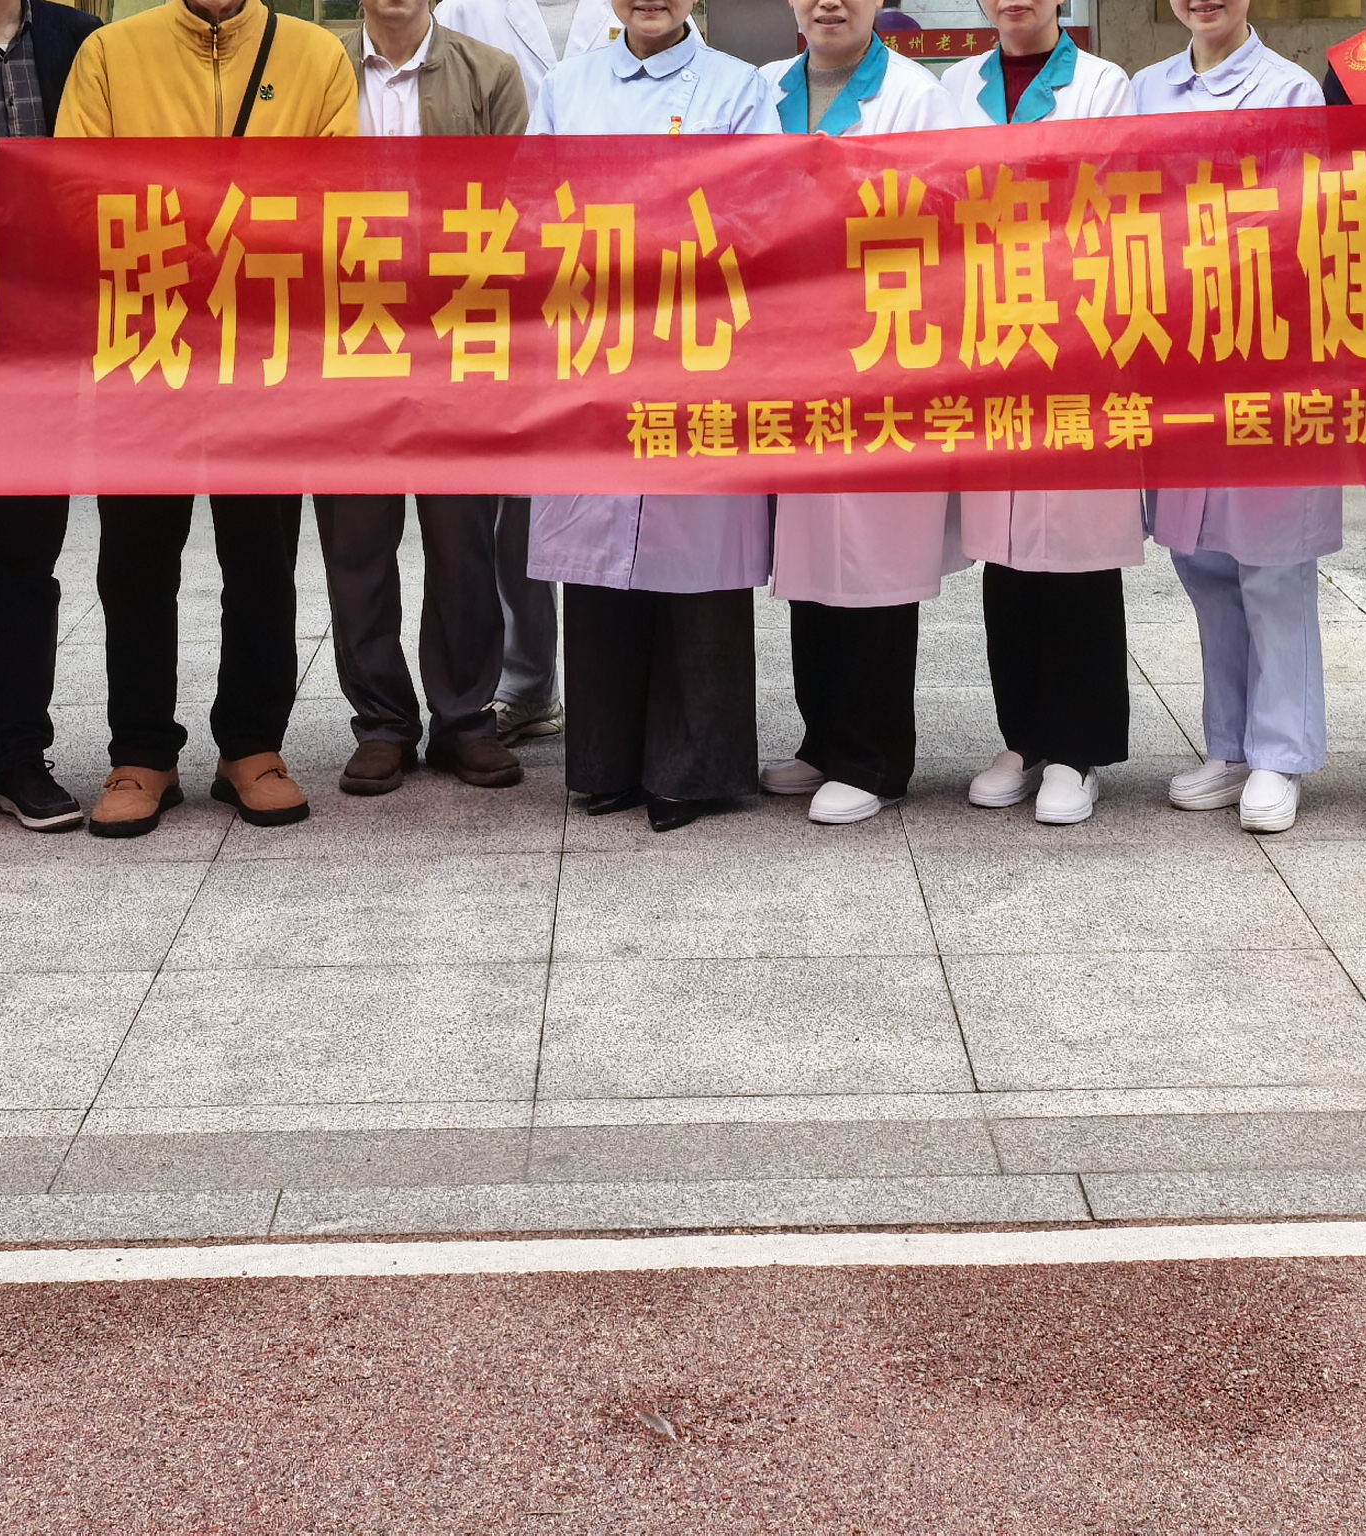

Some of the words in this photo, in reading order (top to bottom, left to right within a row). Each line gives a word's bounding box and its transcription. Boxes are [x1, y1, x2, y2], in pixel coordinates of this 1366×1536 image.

[91, 178, 753, 388] 践行医者初心
